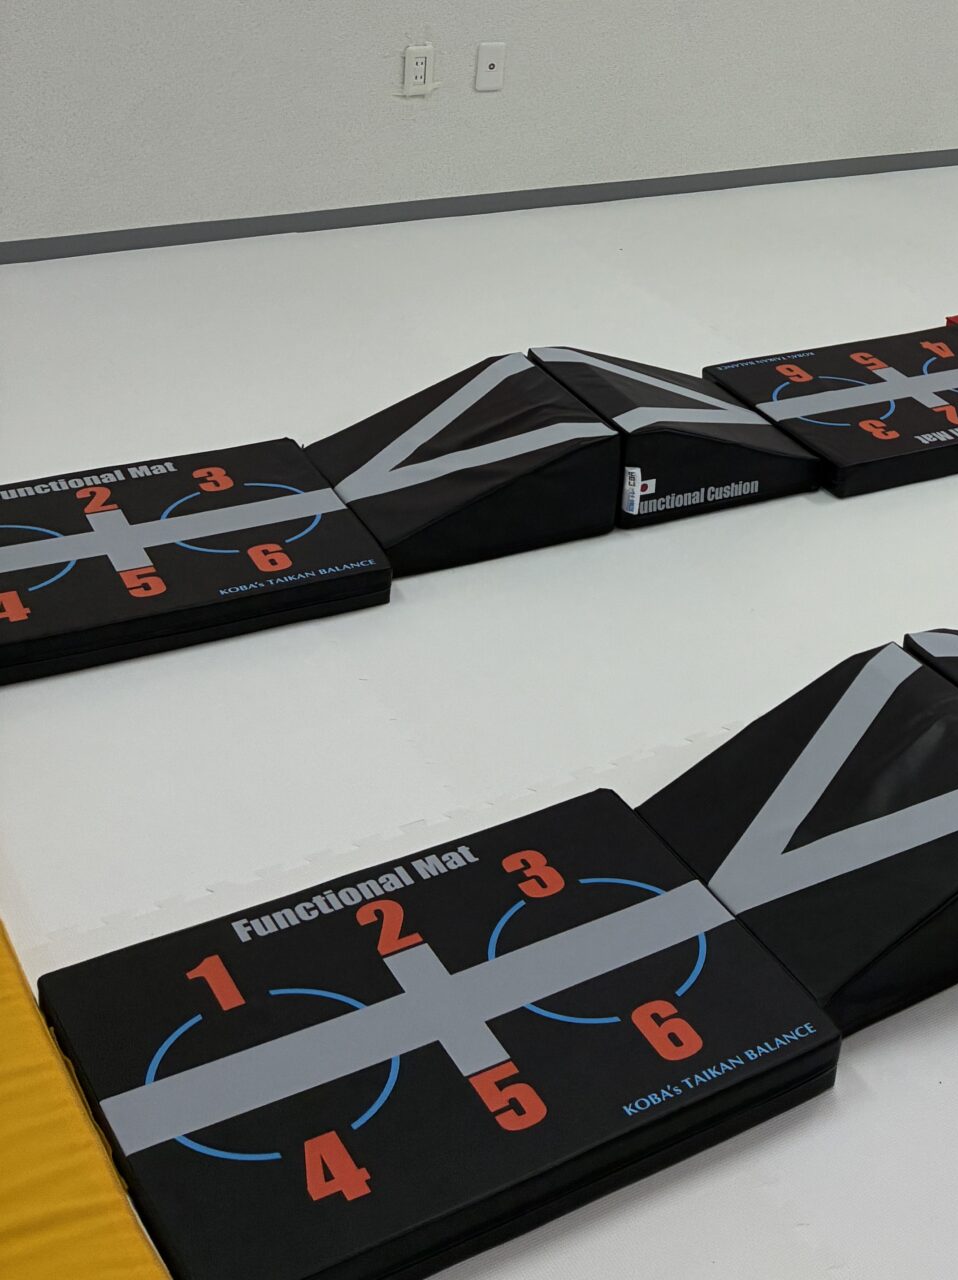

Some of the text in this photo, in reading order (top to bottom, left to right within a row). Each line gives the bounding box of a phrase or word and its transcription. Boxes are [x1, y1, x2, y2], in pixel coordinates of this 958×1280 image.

[849, 352, 888, 370] 5
[920, 341, 955, 358] 4
[775, 363, 814, 383] 6
[859, 420, 899, 440] 3
[914, 431, 955, 445] Mat
[0, 461, 178, 500] unctional Mat
[192, 466, 234, 492] 3
[76, 486, 120, 514] 2
[640, 487, 705, 514] unctional
[707, 480, 759, 501] Cushion
[247, 543, 293, 573] 6
[119, 567, 167, 598] 5
[218, 558, 377, 596] KOBA's TAIKAN BALANCE
[0, 591, 31, 622] 4
[503, 850, 566, 898] 3
[231, 845, 479, 943] Functional Mat
[356, 899, 423, 955] 2
[186, 955, 246, 1011] 1
[631, 1000, 704, 1061] 6
[622, 1022, 817, 1116] KOBA's TAIKAN BALANCE
[466, 1060, 548, 1131] 5
[305, 1132, 371, 1202] 4
